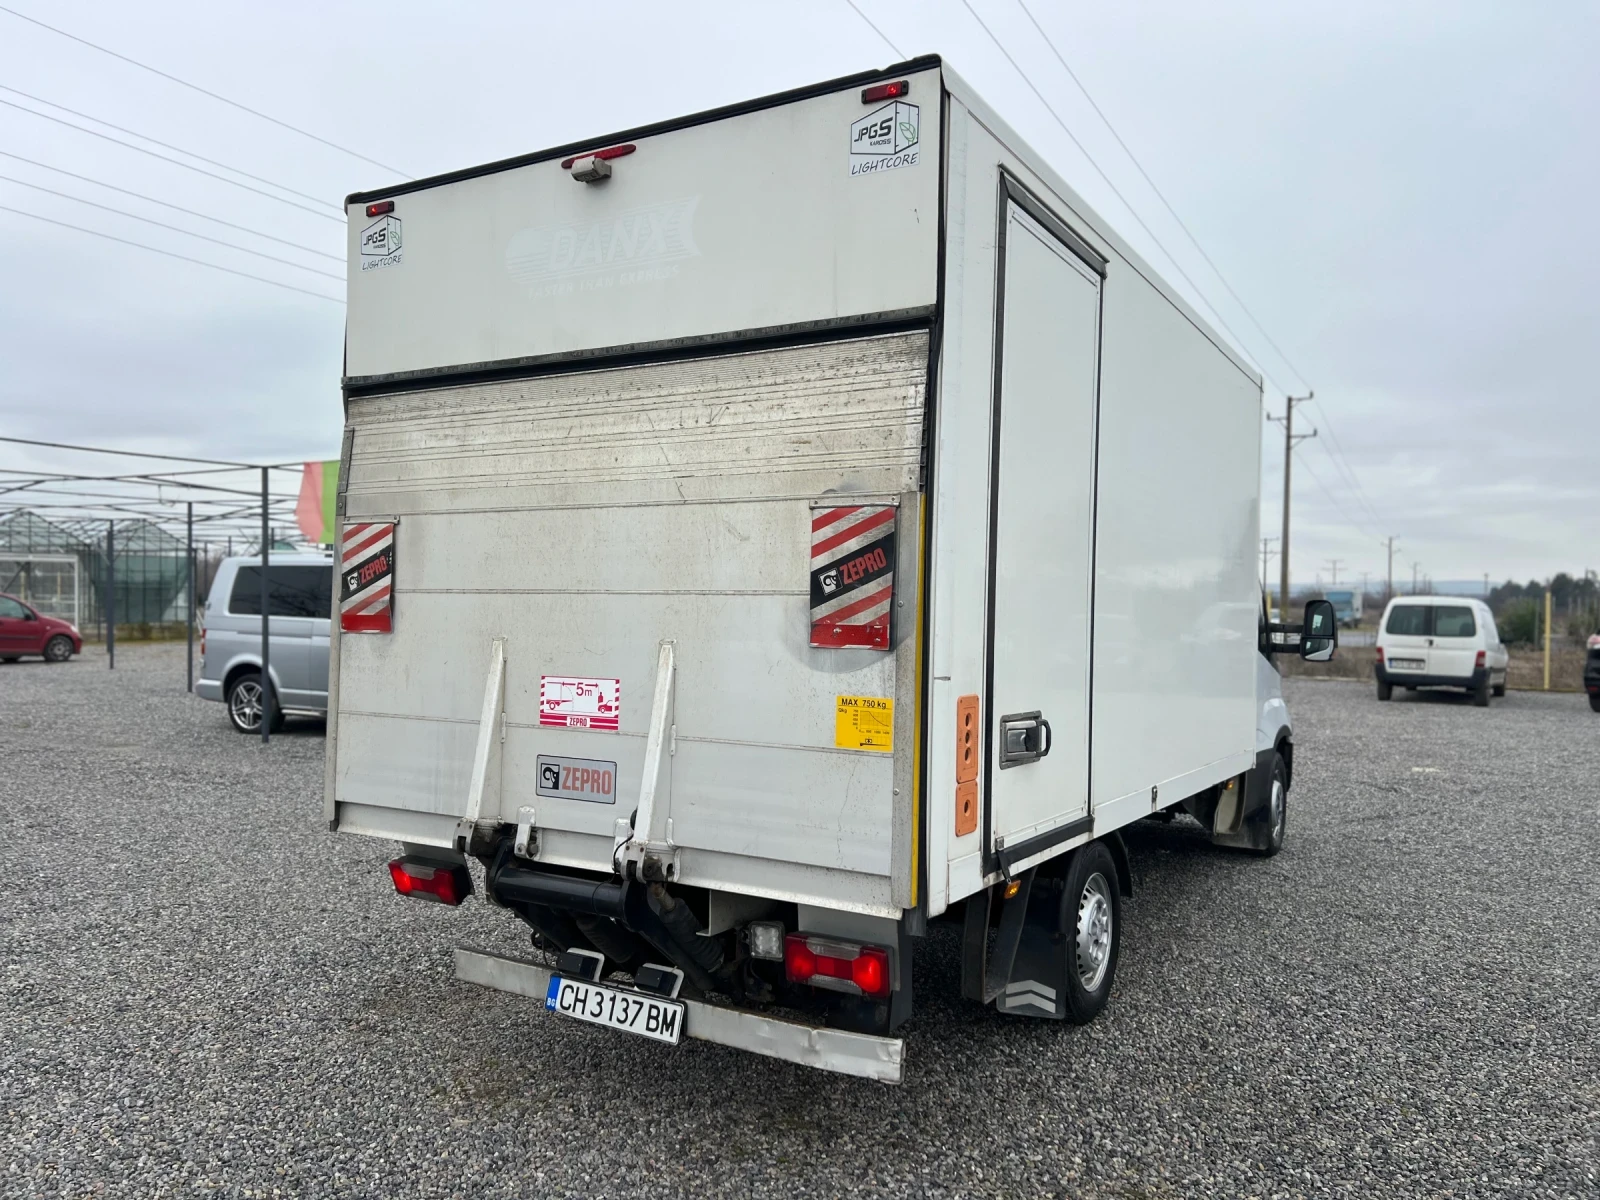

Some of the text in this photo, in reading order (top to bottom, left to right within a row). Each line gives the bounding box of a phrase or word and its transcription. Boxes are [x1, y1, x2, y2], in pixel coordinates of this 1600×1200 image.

[854, 117, 893, 142] JPGS
[851, 152, 918, 175] LIGHTCORE
[363, 227, 387, 246] JPGS
[549, 208, 675, 270] DANX
[362, 254, 402, 271] LIGHTCORE
[359, 555, 387, 584] ZEPRO
[840, 547, 887, 584] ZEPRO
[841, 698, 887, 710] MAX 750 kg
[569, 717, 588, 727] ZEPRO
[562, 766, 613, 795] ZEPRO
[547, 997, 556, 1007] BG
